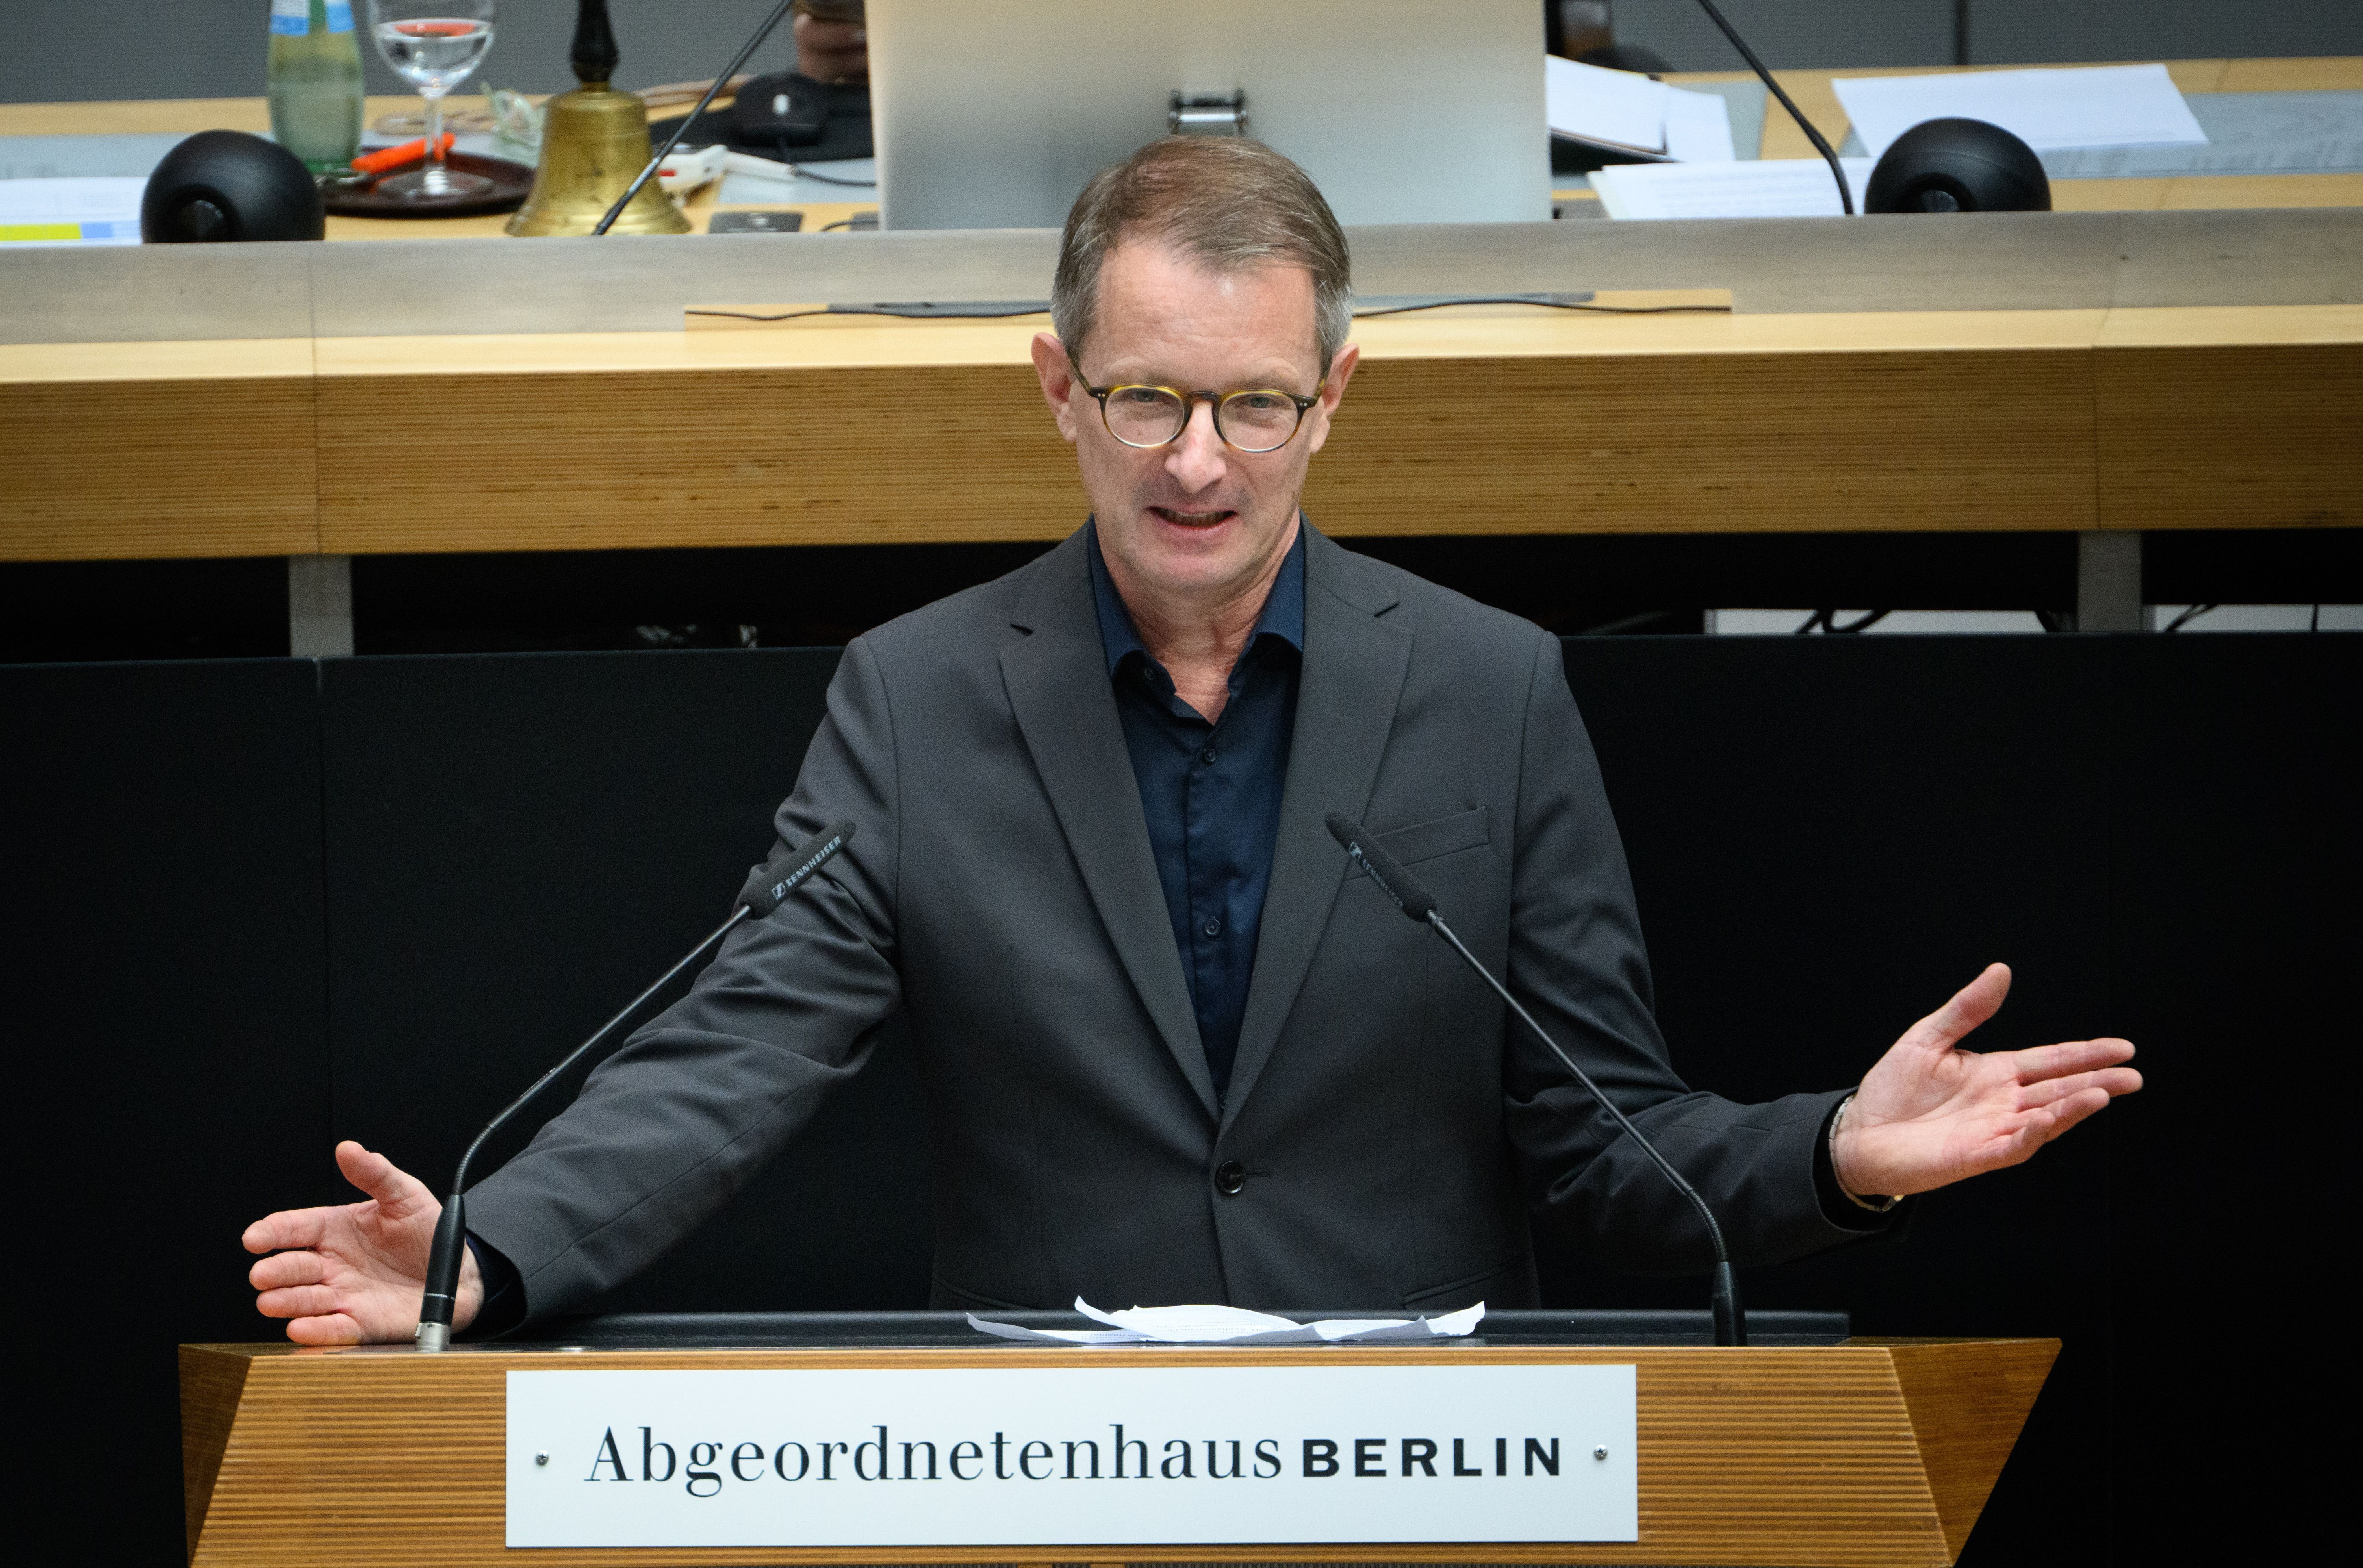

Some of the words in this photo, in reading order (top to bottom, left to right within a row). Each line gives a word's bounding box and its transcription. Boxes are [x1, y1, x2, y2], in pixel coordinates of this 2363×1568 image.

[785, 836, 842, 887] SENNHEISER
[584, 1423, 1282, 1498] Abgeordnetenhaus
[1302, 1437, 1560, 1478] BERLIN
